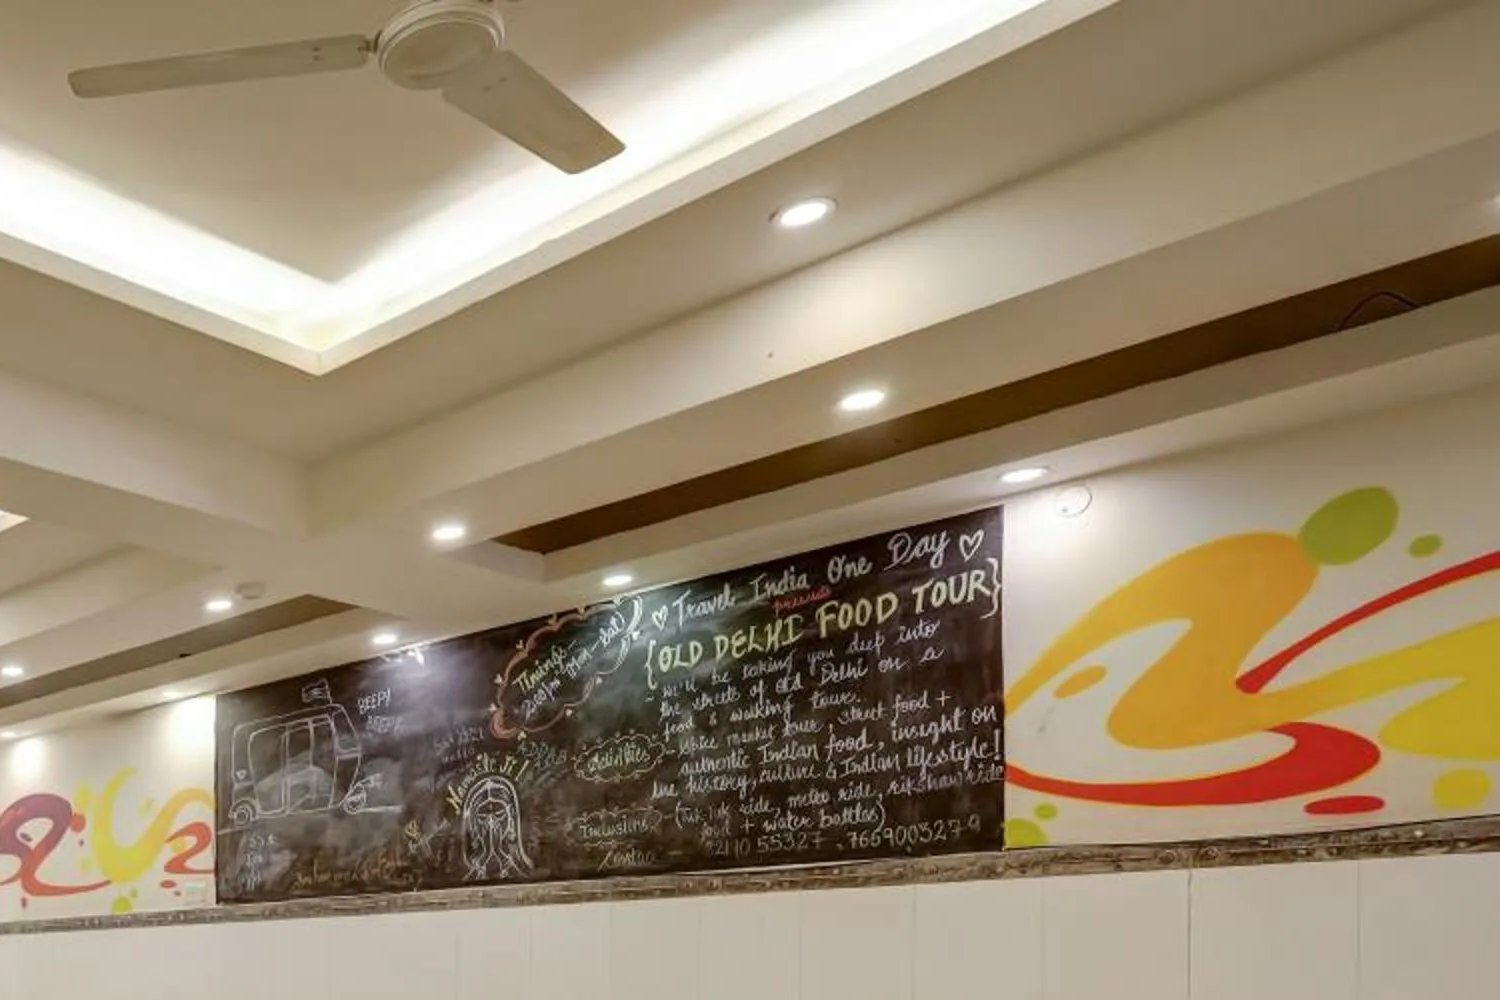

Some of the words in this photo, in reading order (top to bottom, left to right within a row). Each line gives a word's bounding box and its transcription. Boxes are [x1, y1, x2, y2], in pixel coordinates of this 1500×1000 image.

[672, 582, 735, 628] Travel
[749, 565, 811, 601] India
[827, 555, 873, 584] One
[884, 530, 950, 571] Day
[711, 669, 732, 686] be
[806, 649, 835, 677] you
[846, 630, 886, 656] deep
[896, 619, 941, 645] into
[713, 614, 804, 662] DELHI
[815, 592, 899, 639] FOOD
[660, 701, 682, 718] the
[691, 685, 741, 710] streets
[749, 679, 764, 704] of
[818, 657, 870, 686] Delhi
[877, 658, 909, 673] on
[919, 647, 945, 665] a
[662, 717, 695, 743] food
[729, 693, 795, 725] walking
[678, 749, 752, 777] authentic
[757, 741, 820, 764] Indian
[891, 706, 967, 745] insight
[971, 704, 998, 726] on
[726, 724, 779, 748] market
[837, 701, 889, 725] street
[892, 690, 931, 723] food
[651, 780, 679, 800] the
[759, 763, 821, 783] culture
[838, 752, 901, 778] Indian
[787, 788, 831, 808] metro
[967, 763, 1004, 784] ride
[762, 811, 815, 832] water
